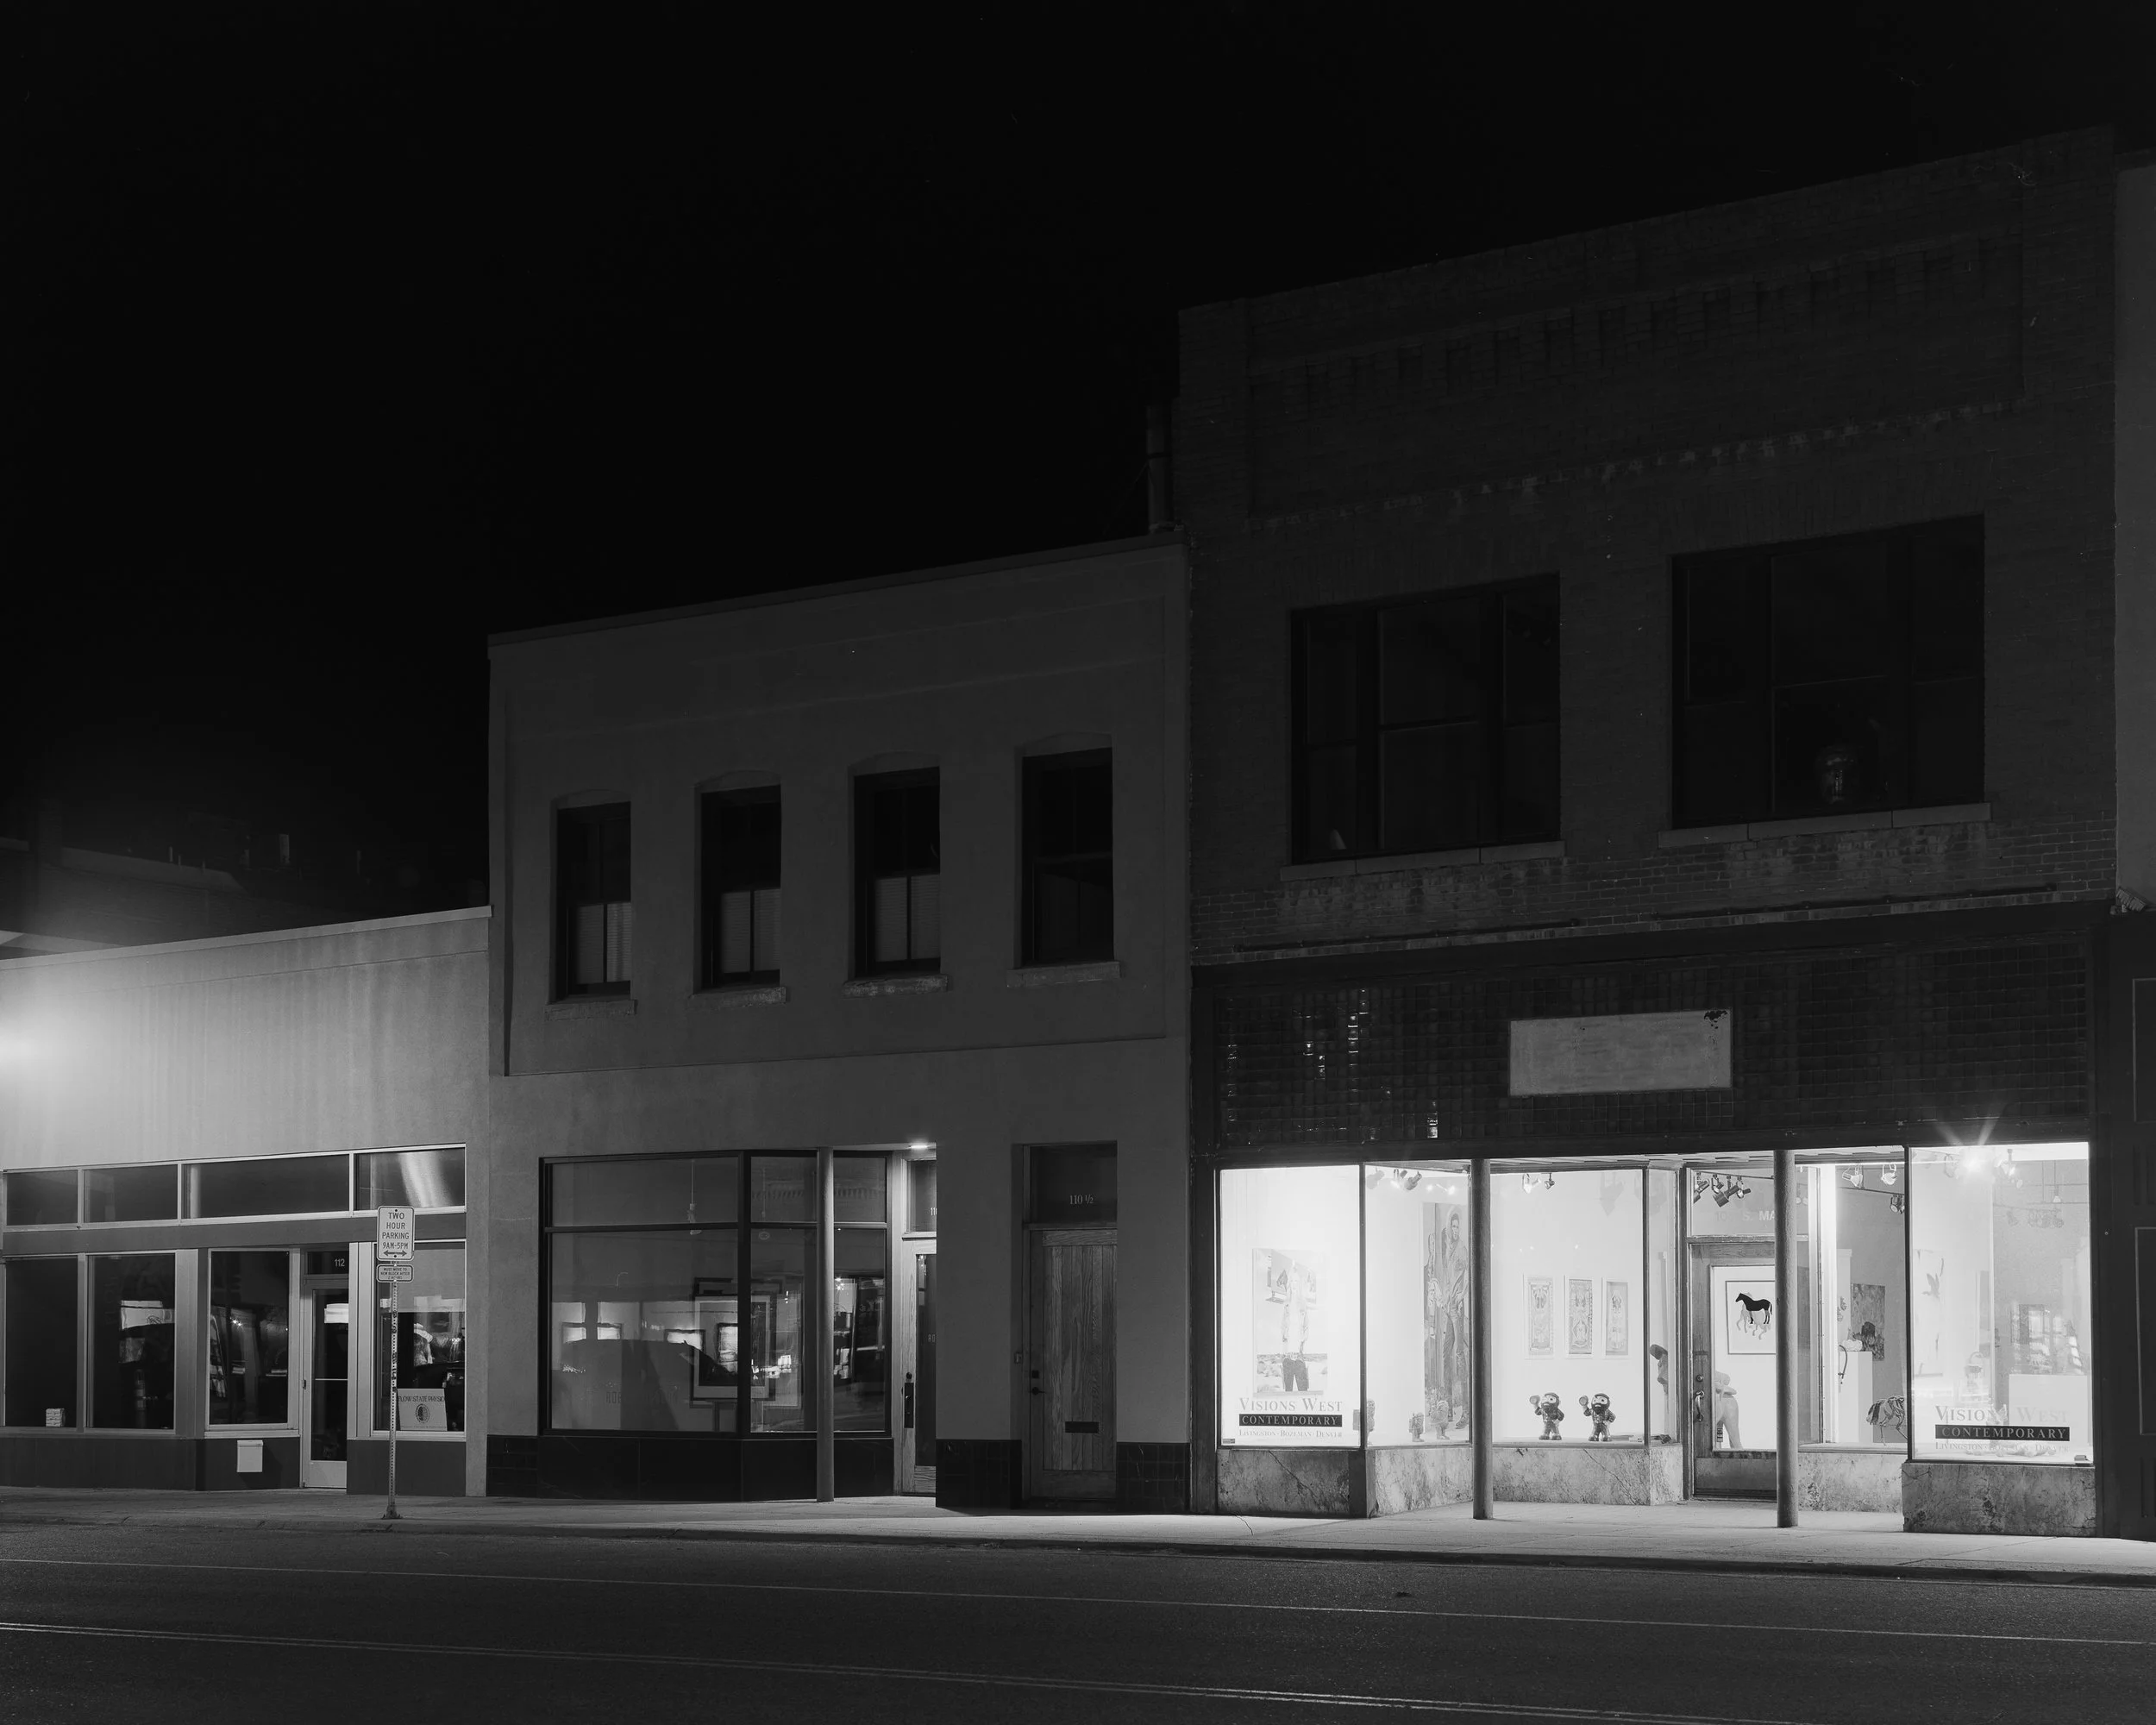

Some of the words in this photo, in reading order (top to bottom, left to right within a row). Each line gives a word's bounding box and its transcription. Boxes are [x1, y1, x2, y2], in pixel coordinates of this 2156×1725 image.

[1069, 1195, 1083, 1205] 110
[334, 1258, 345, 1267] 112
[1239, 1397, 1296, 1412] VISIONS
[1301, 1397, 1343, 1413] WEST
[1935, 1405, 2007, 1422] VISION
[2016, 1406, 2069, 1422] WEST
[1242, 1414, 1338, 1426] CONTEMPORARY
[1238, 1428, 1276, 1437] LIVINGSTON
[1280, 1429, 1312, 1438] BOZEMAN
[1315, 1429, 1343, 1438] DENVER
[1942, 1427, 2066, 1440] CONTEMPORARY
[1935, 1441, 1984, 1451] LIVINGSTON
